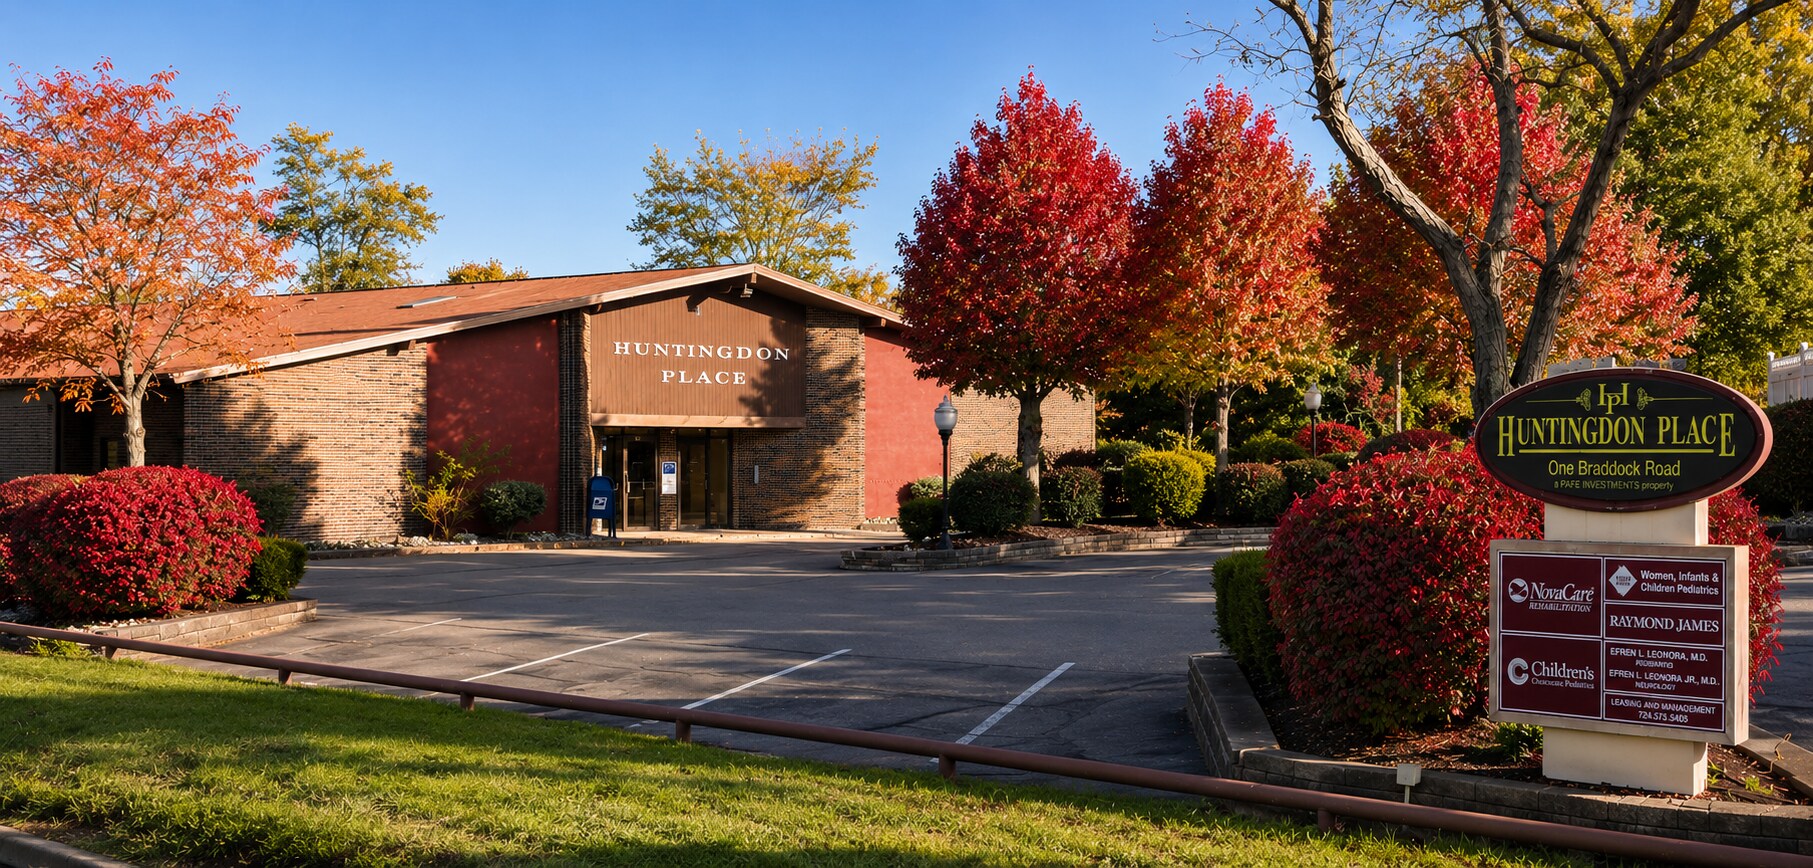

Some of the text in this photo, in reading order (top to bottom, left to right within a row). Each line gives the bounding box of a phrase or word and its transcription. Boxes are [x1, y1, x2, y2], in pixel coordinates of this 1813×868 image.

[613, 341, 789, 361] HUNTINGDON
[661, 370, 746, 385] PLACE
[1497, 413, 1736, 457] HUNTINGDON PLACE
[1548, 459, 1681, 476] One Braddock Road
[1582, 480, 1640, 490] INVESTMENTS
[1641, 481, 1674, 492] property
[1640, 570, 1677, 582] Women,
[1678, 572, 1710, 582] Infants
[1711, 572, 1719, 582] &
[1530, 582, 1594, 602] NovaCare
[1640, 582, 1719, 595] Children Pediatrics
[1529, 602, 1592, 612] REHABILITATION
[1609, 615, 1720, 633] RAYMOND JAMES
[1610, 647, 1637, 657] EFREN
[1531, 661, 1595, 680] Children's
[1609, 669, 1635, 679] EFREN
[1611, 698, 1642, 708] LEASING
[1643, 701, 1659, 710] AND
